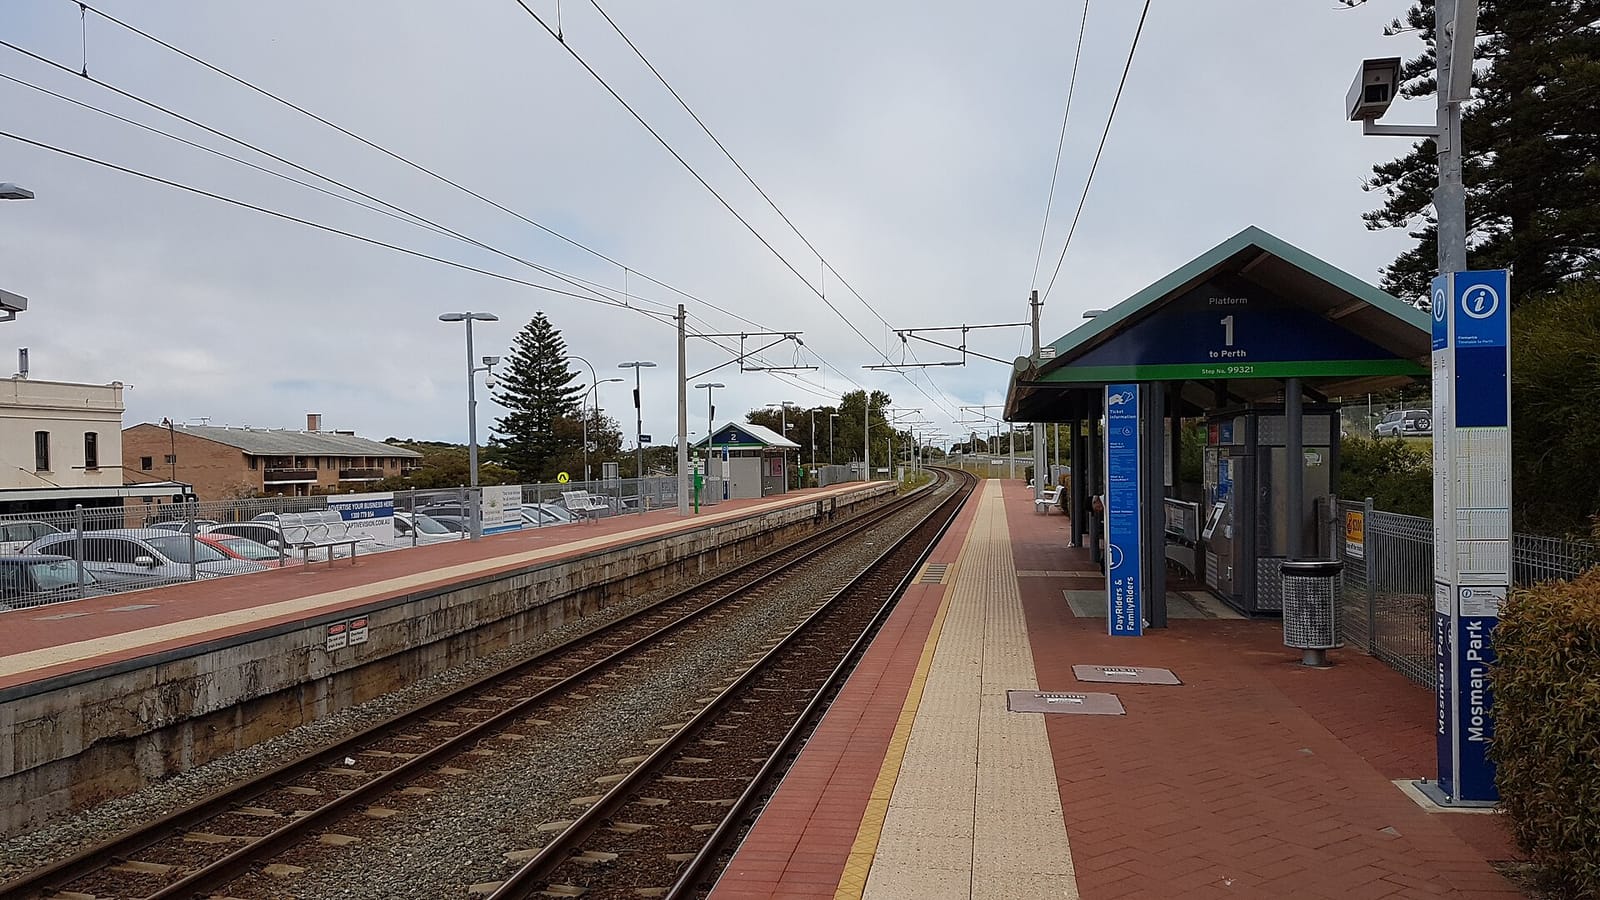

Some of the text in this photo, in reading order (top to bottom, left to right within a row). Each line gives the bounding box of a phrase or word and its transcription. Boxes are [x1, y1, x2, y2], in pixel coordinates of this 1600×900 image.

[1209, 297, 1248, 305] Platform
[1220, 315, 1233, 346] 1
[1209, 349, 1247, 358] to Perth
[1227, 366, 1254, 374] 99321
[731, 433, 737, 441] 2
[328, 503, 352, 511] ADVERTISE
[352, 502, 364, 510] YOUR
[364, 501, 383, 509] BUSINESS
[1115, 587, 1124, 631] DayRiders
[1126, 576, 1136, 631] FamilyRiders
[1466, 620, 1482, 661] Park
[1468, 667, 1484, 742] Mosman
